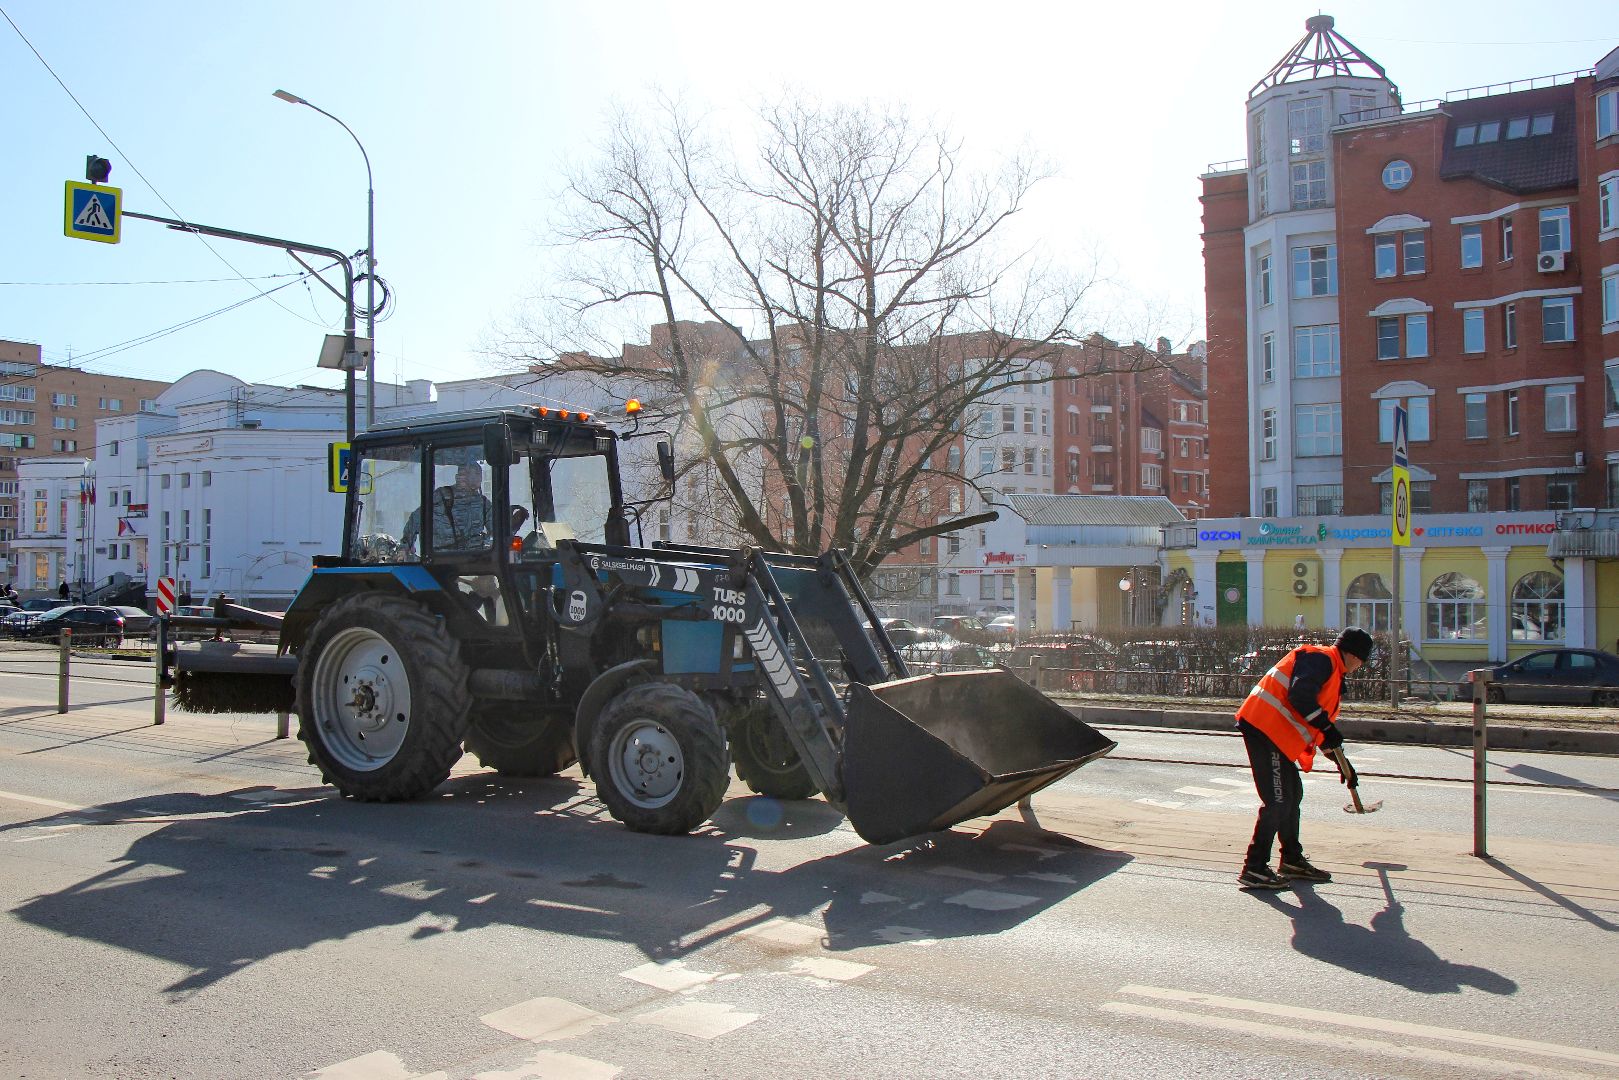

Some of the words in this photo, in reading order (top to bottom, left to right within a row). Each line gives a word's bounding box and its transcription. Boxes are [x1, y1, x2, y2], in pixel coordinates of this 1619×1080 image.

[1199, 530, 1241, 541] OZON
[1247, 535, 1317, 545] ХИМЧИСТКА
[712, 586, 746, 606] TURS
[569, 605, 585, 616] 1000
[711, 605, 746, 624] 1000
[1271, 751, 1284, 803] REVISION
